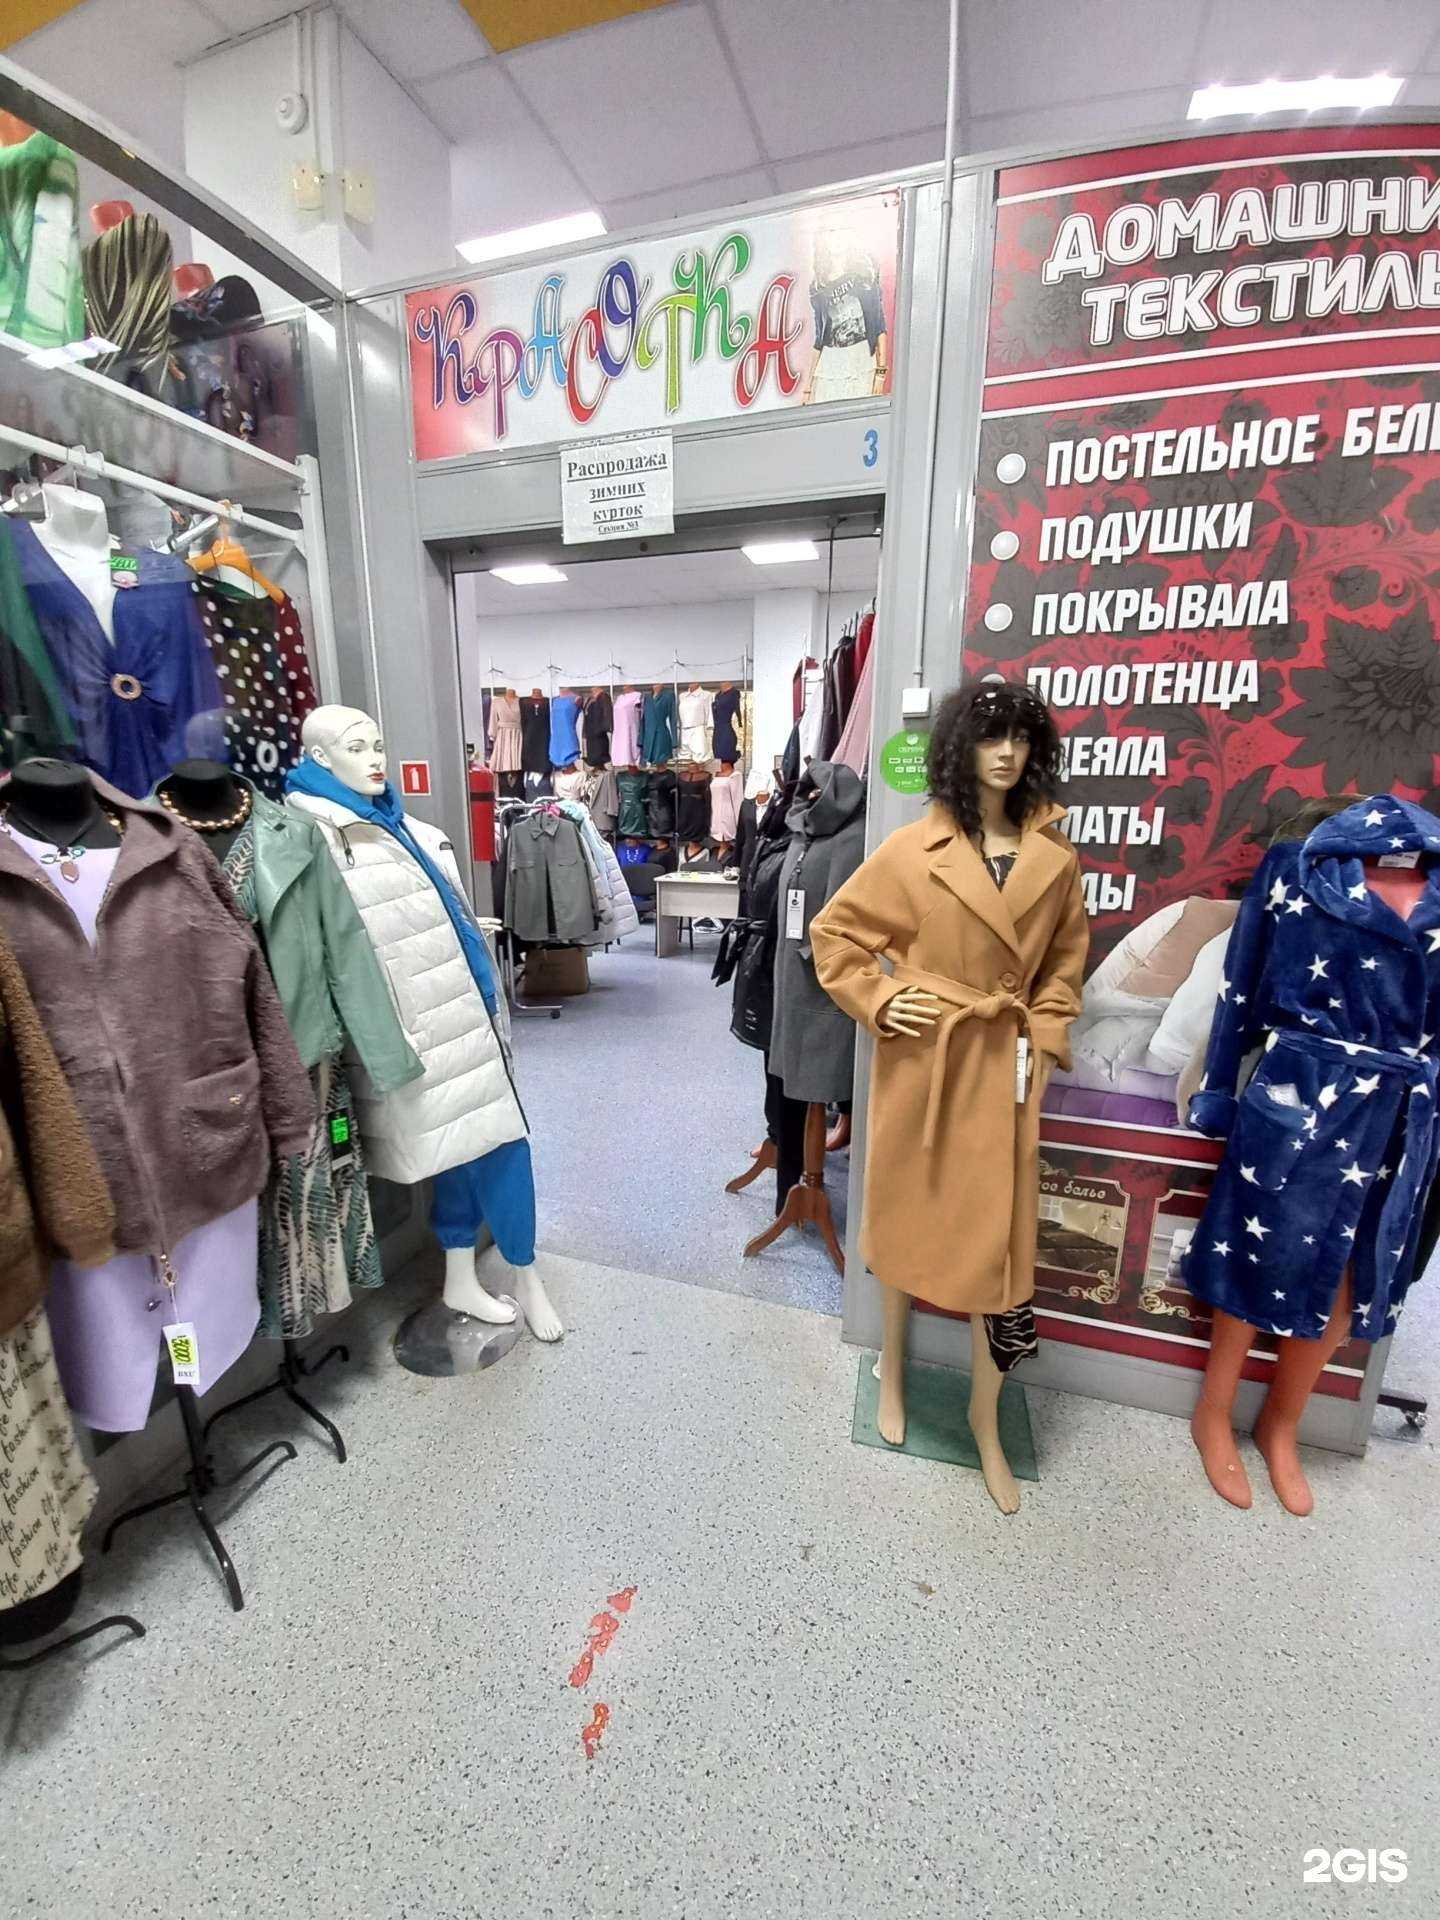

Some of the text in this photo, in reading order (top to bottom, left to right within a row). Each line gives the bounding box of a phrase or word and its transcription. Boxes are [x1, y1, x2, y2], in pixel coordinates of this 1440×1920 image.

[567, 452, 667, 478] Распродажа
[863, 429, 878, 467] 3
[1045, 414, 1321, 487] ПОСТЕЛЬНОЕ
[590, 482, 645, 499] зимних
[593, 505, 643, 521] курток
[1038, 501, 1253, 565] ПОДУШКИ
[1031, 580, 1288, 636] ПОКРЫВАЛА
[1027, 660, 1259, 710] ПОЛОТЕНЦА
[1056, 805, 1165, 845] ЛАТЫ
[1039, 1181, 1058, 1191] ое
